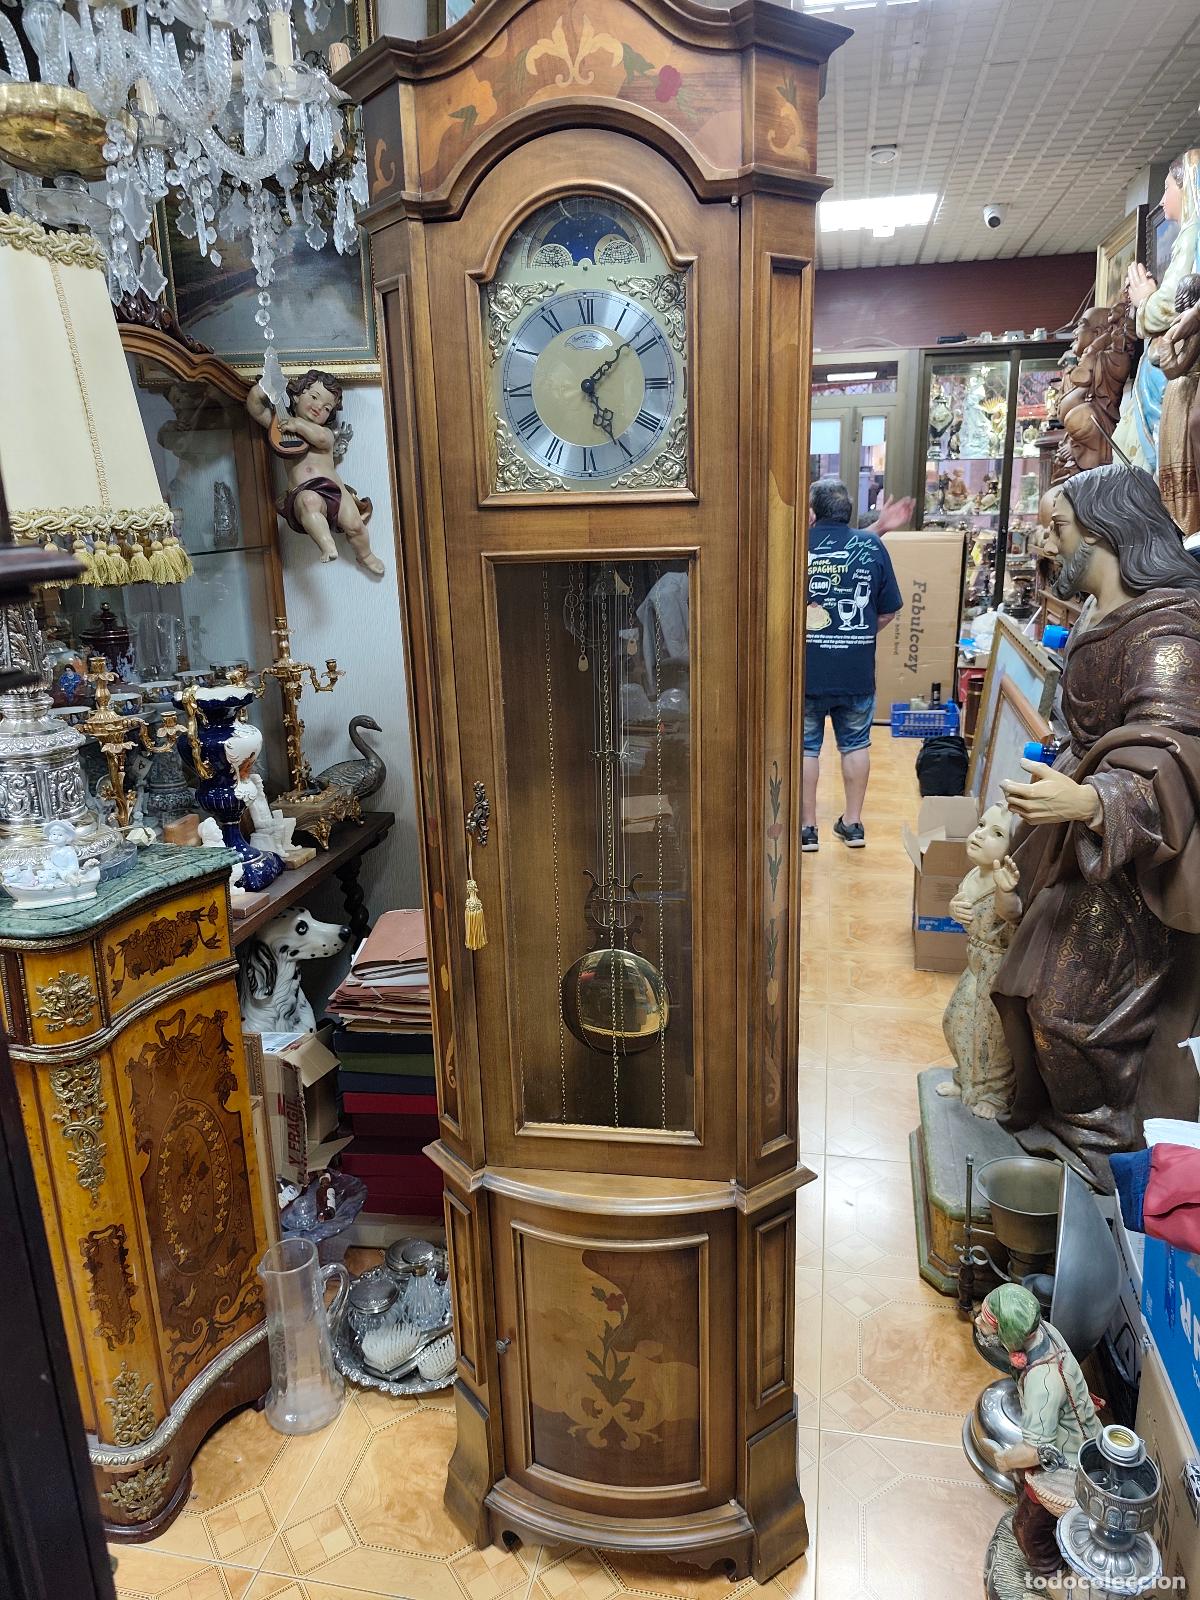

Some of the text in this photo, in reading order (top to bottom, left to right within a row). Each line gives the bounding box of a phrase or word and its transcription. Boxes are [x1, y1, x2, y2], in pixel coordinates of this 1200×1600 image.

[814, 534, 837, 551] La
[845, 548, 875, 566] Vita
[808, 565, 848, 575] SPAGHETTI
[904, 580, 927, 673] Fabulcozy
